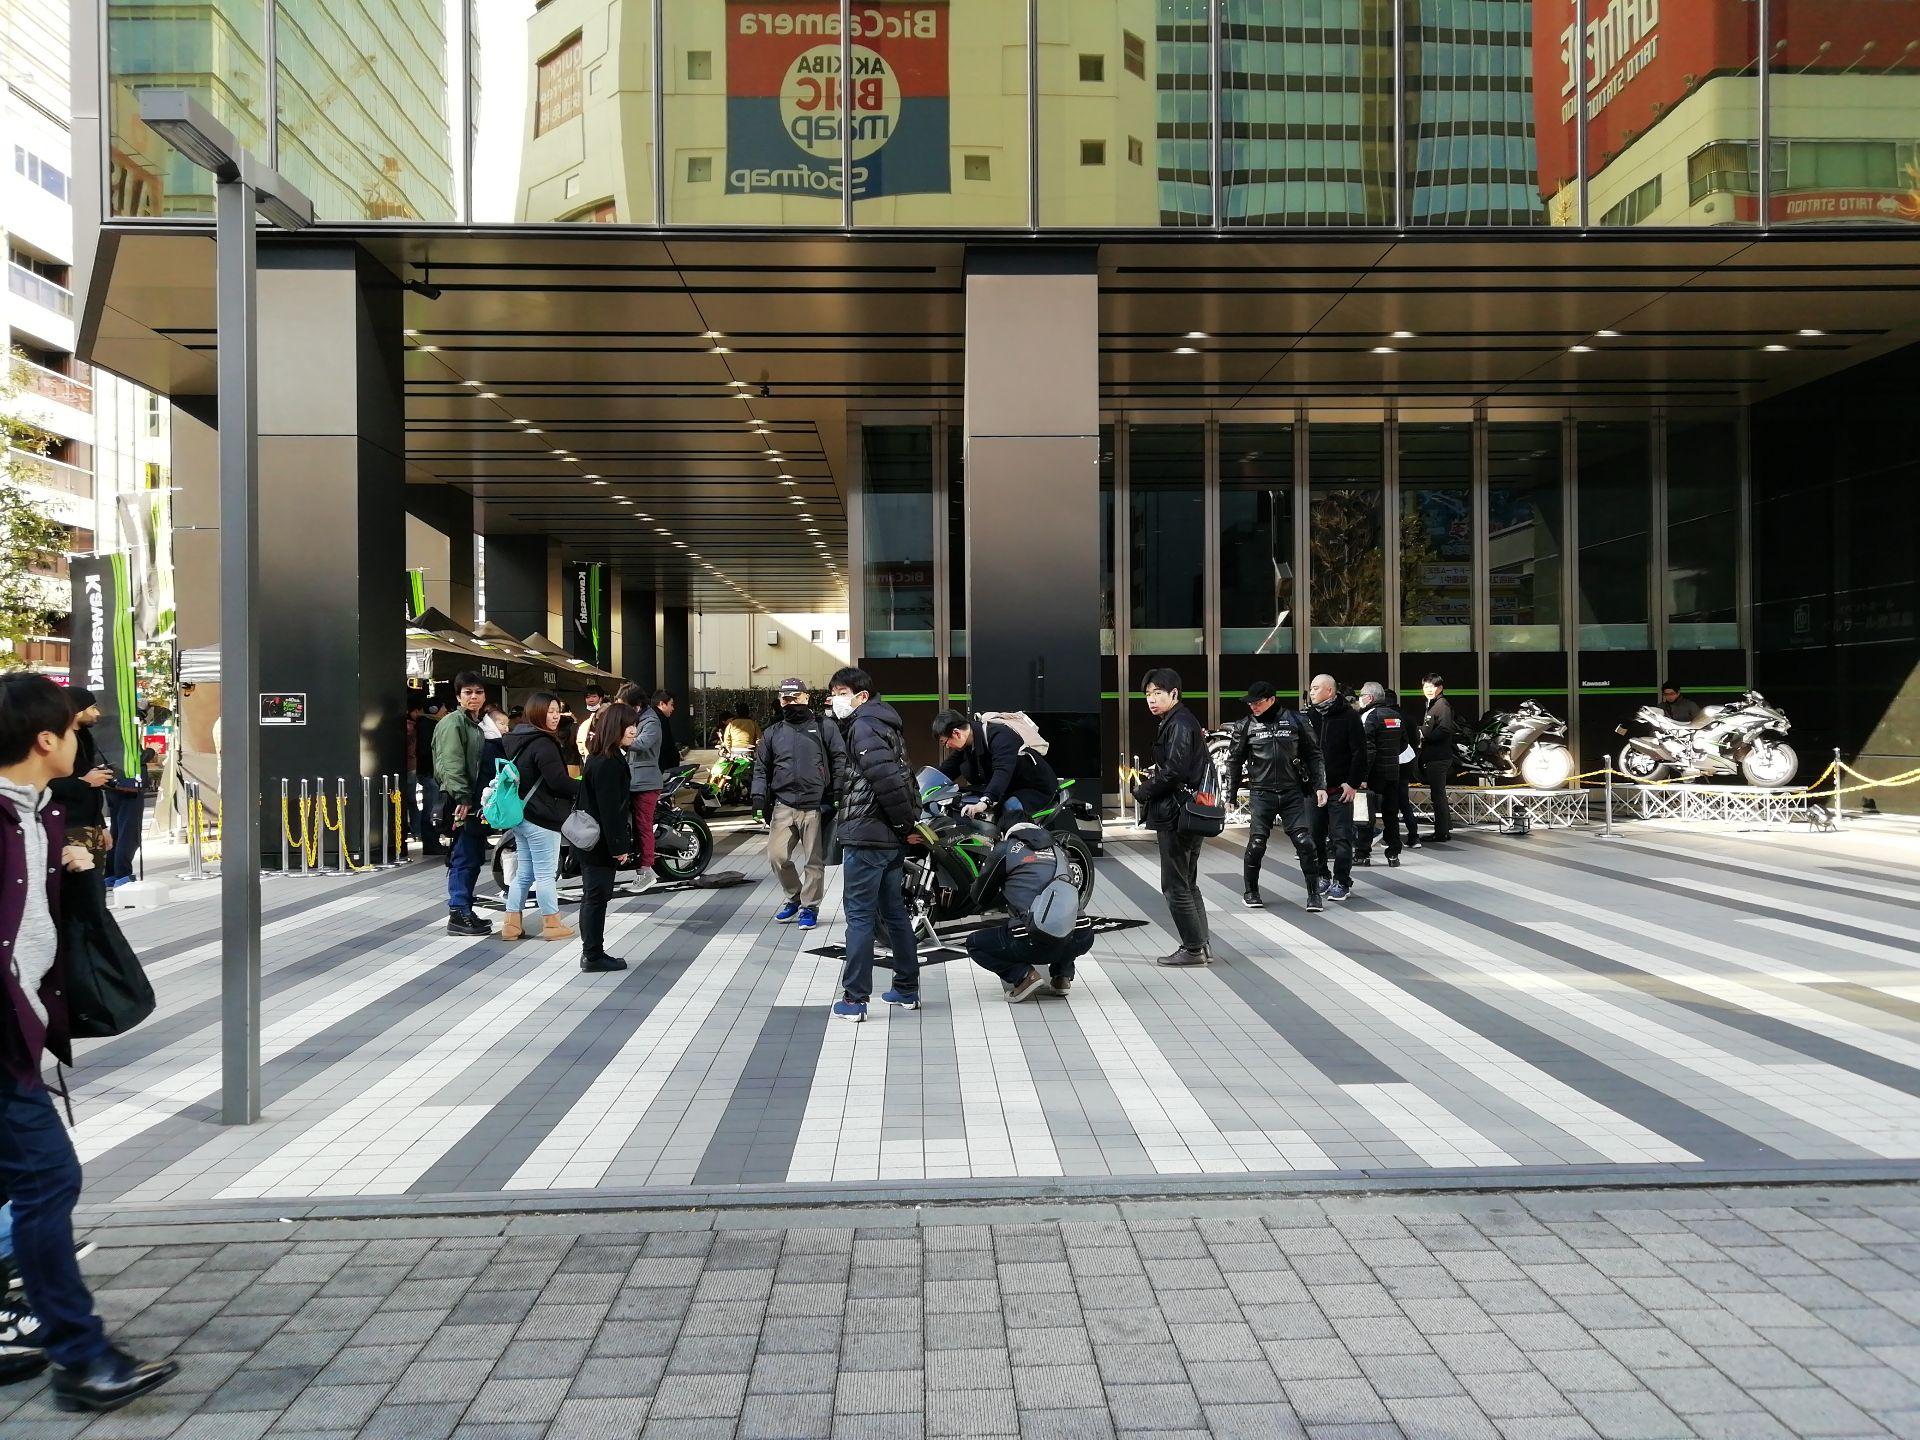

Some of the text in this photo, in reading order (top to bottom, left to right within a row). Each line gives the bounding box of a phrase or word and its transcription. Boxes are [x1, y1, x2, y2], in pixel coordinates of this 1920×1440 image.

[578, 571, 588, 624] Kawasaki
[85, 574, 104, 692] Kawasaki
[481, 664, 499, 679] PLAZA
